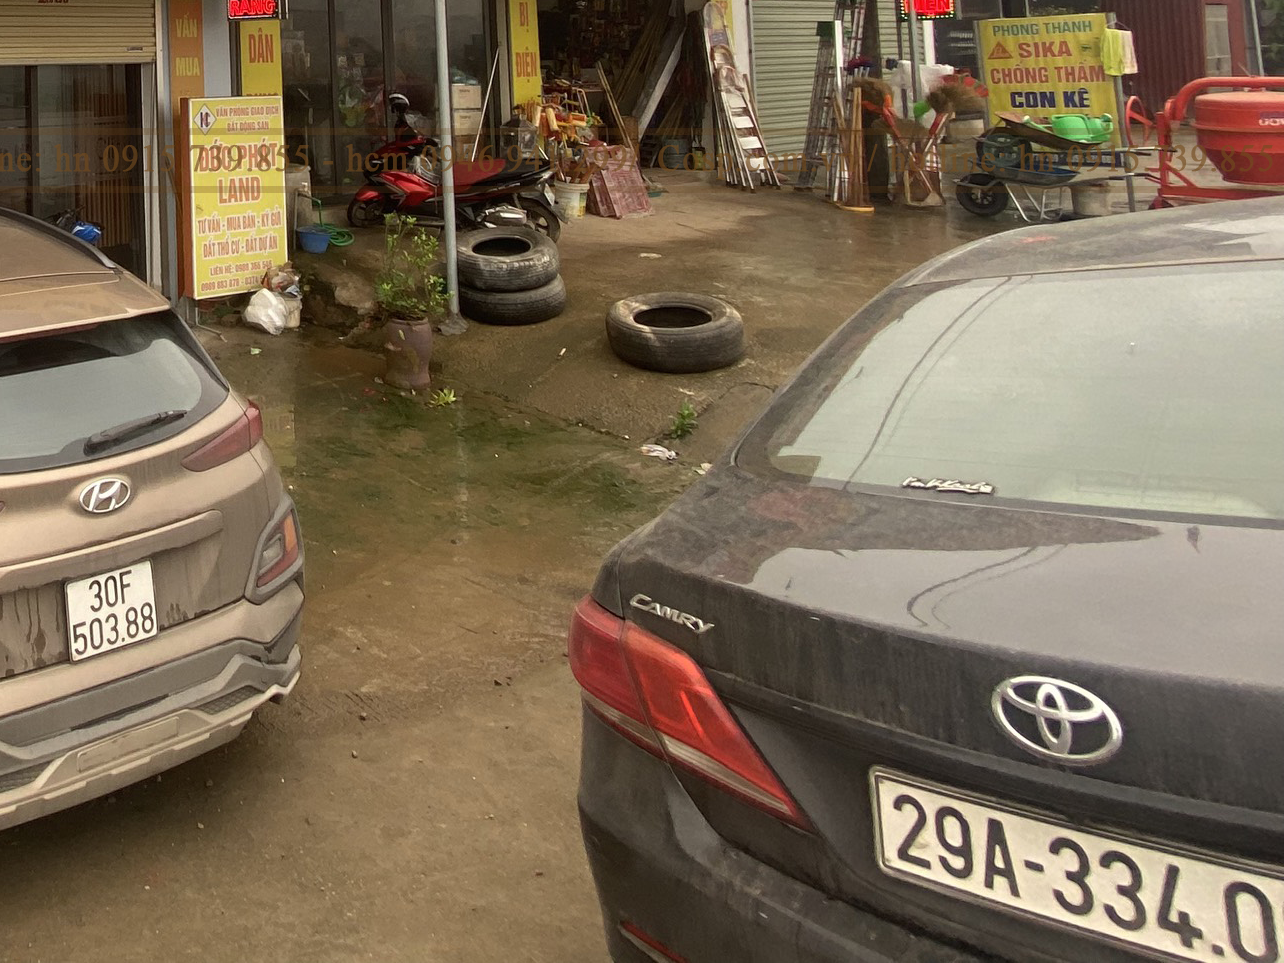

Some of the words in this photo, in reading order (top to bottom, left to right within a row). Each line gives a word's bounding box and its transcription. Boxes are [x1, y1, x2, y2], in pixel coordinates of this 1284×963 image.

[992, 23, 1039, 37] PHONG
[248, 28, 274, 64] DÂN
[1018, 41, 1073, 59] SIKA
[175, 57, 200, 77] MUA
[1010, 91, 1056, 108] CON
[1063, 87, 1091, 108] KÊ
[218, 176, 261, 205] LAND
[226, 216, 241, 232] MUA
[87, 571, 132, 614] 30F
[629, 593, 715, 634] CAMRY
[73, 602, 155, 655] 503.88
[893, 793, 1284, 963] 29A-334.0
